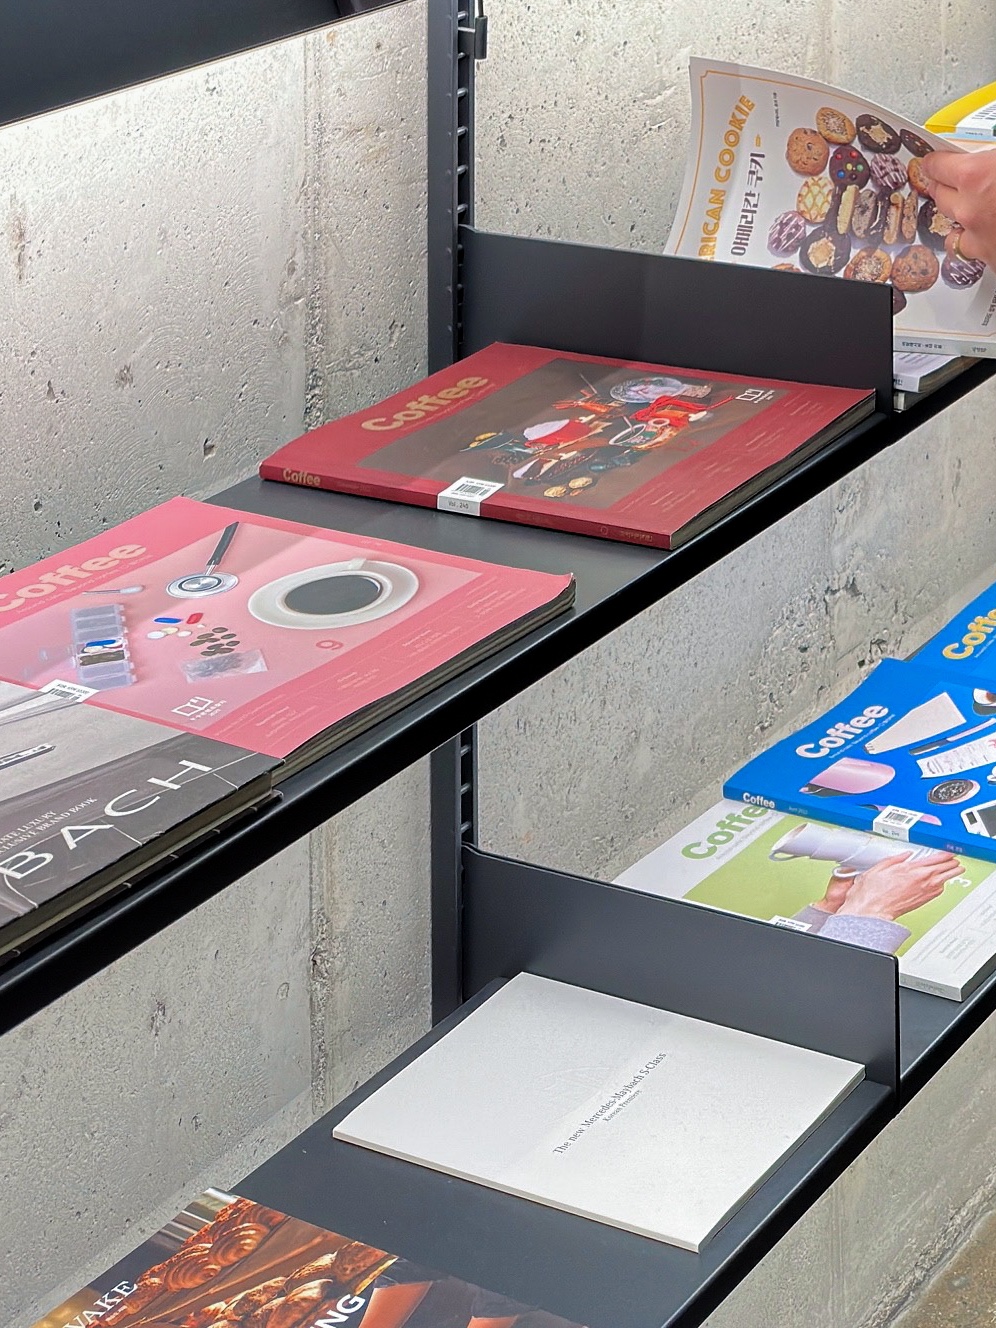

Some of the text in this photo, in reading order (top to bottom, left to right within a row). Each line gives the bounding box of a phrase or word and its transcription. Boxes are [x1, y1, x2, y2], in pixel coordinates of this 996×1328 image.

[714, 95, 756, 183] COOKIE
[730, 152, 765, 256] 아메리칸 쿠키
[361, 376, 489, 431] Coffee
[282, 468, 321, 485] Coffee
[795, 705, 890, 759] Coffee
[19, 810, 57, 833] LUXURY
[37, 812, 71, 832] BRAND
[742, 792, 776, 809] Coffee
[553, 1052, 667, 1154] The new Mercedes-Maybach S-Class
[603, 1089, 642, 1122] Korean Premiere
